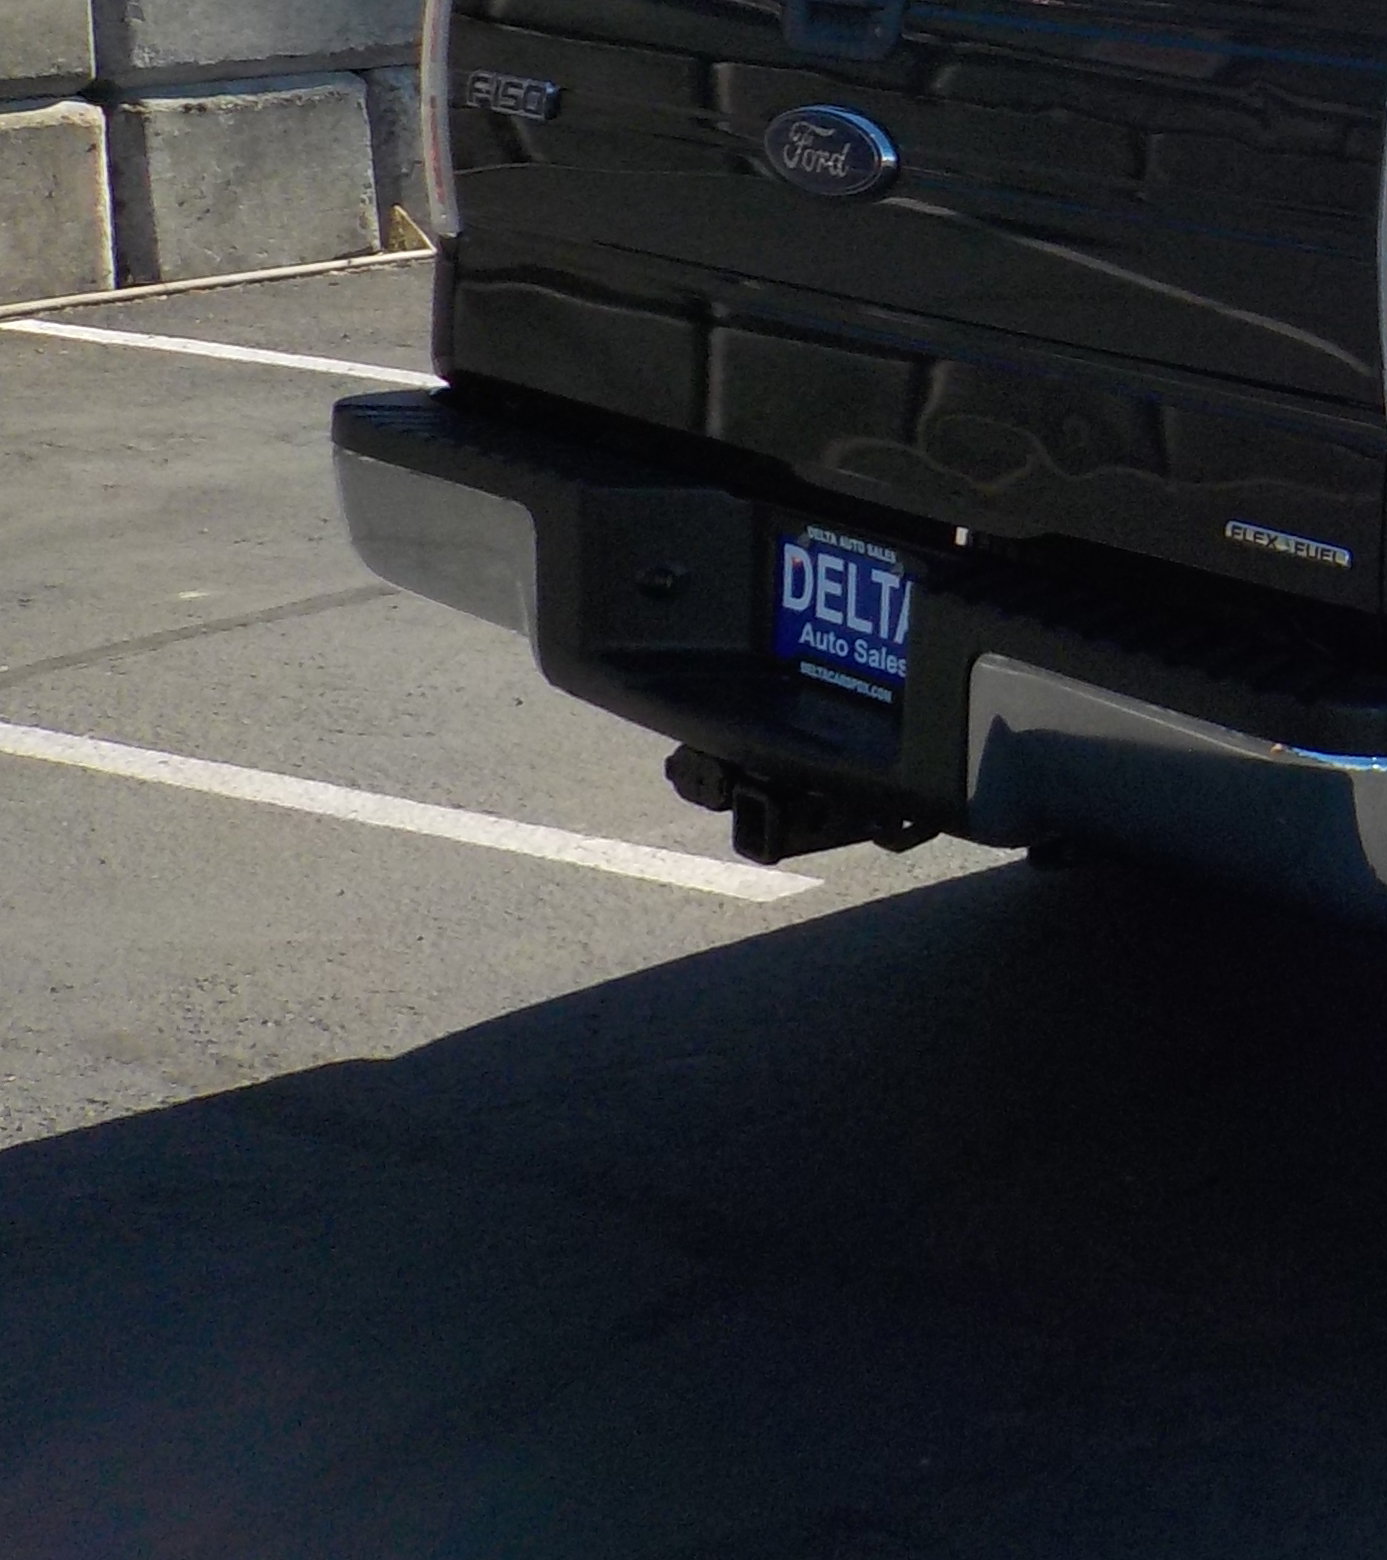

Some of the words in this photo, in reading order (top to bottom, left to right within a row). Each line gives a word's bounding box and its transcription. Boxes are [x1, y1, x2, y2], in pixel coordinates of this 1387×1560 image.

[783, 120, 851, 178] Ford
[806, 525, 838, 546] DELTA
[839, 535, 866, 555] AUTO
[866, 543, 897, 564] SALES
[1231, 525, 1278, 550] FLEX
[1294, 541, 1347, 565] FUEL
[799, 622, 849, 657] Auto
[853, 639, 907, 678] Sales
